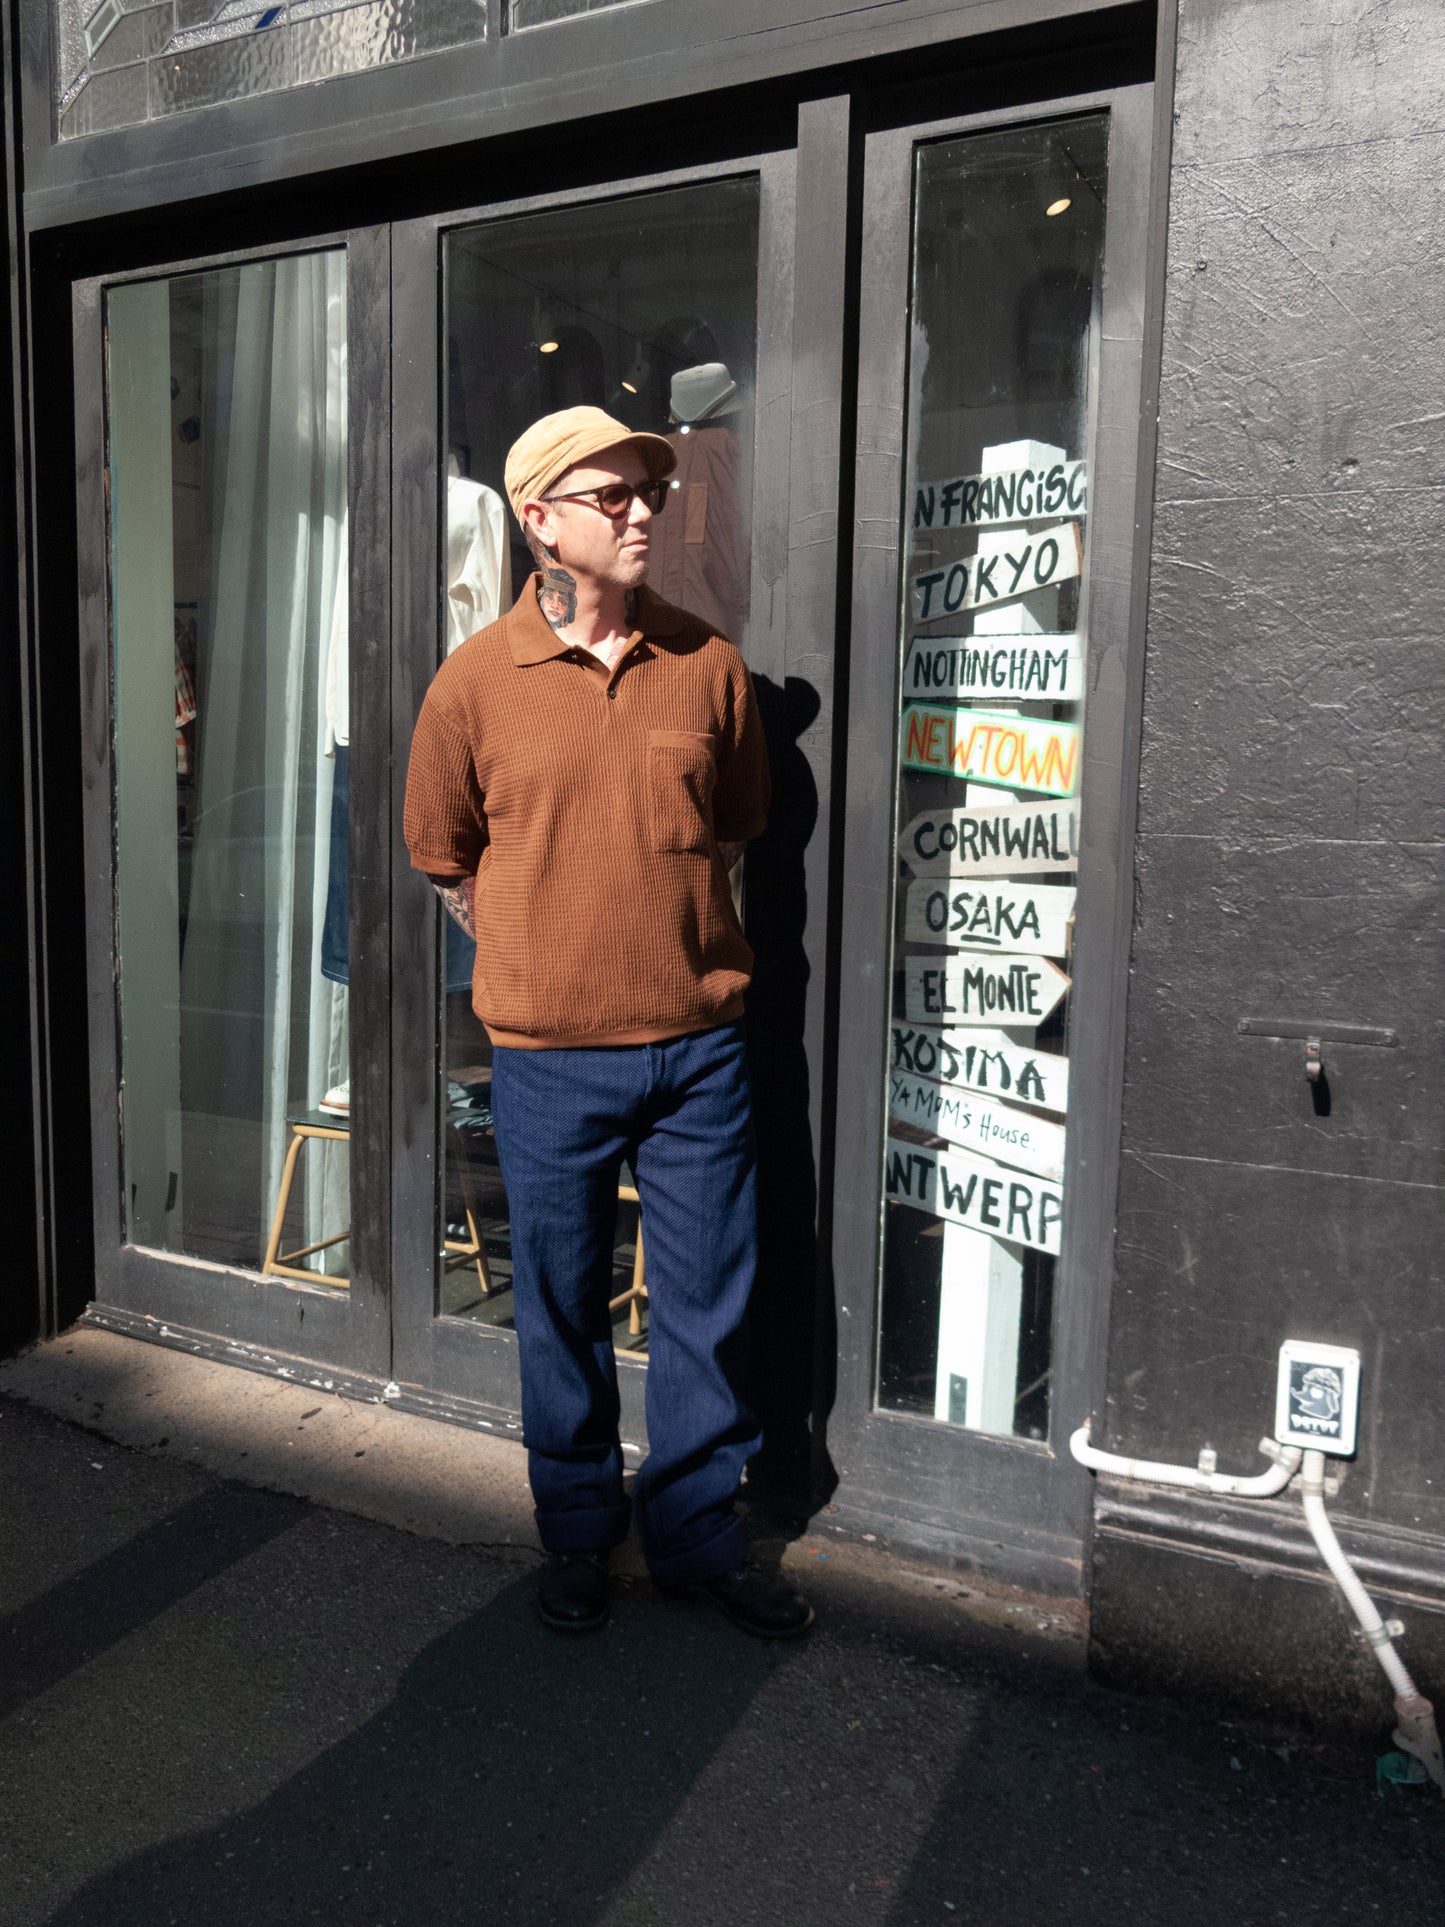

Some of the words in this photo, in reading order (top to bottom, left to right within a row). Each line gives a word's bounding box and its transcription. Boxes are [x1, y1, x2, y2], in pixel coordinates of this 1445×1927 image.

[913, 486, 934, 528] N
[916, 538, 1059, 618] TOKYO
[914, 649, 1069, 692] NOTTINGHAM
[907, 713, 1076, 793] NEWTOWN
[926, 890, 1041, 940] OSAKA
[923, 970, 957, 1013] EL
[963, 964, 1043, 1016] MONTE
[893, 1028, 1048, 1102] KOJIMA
